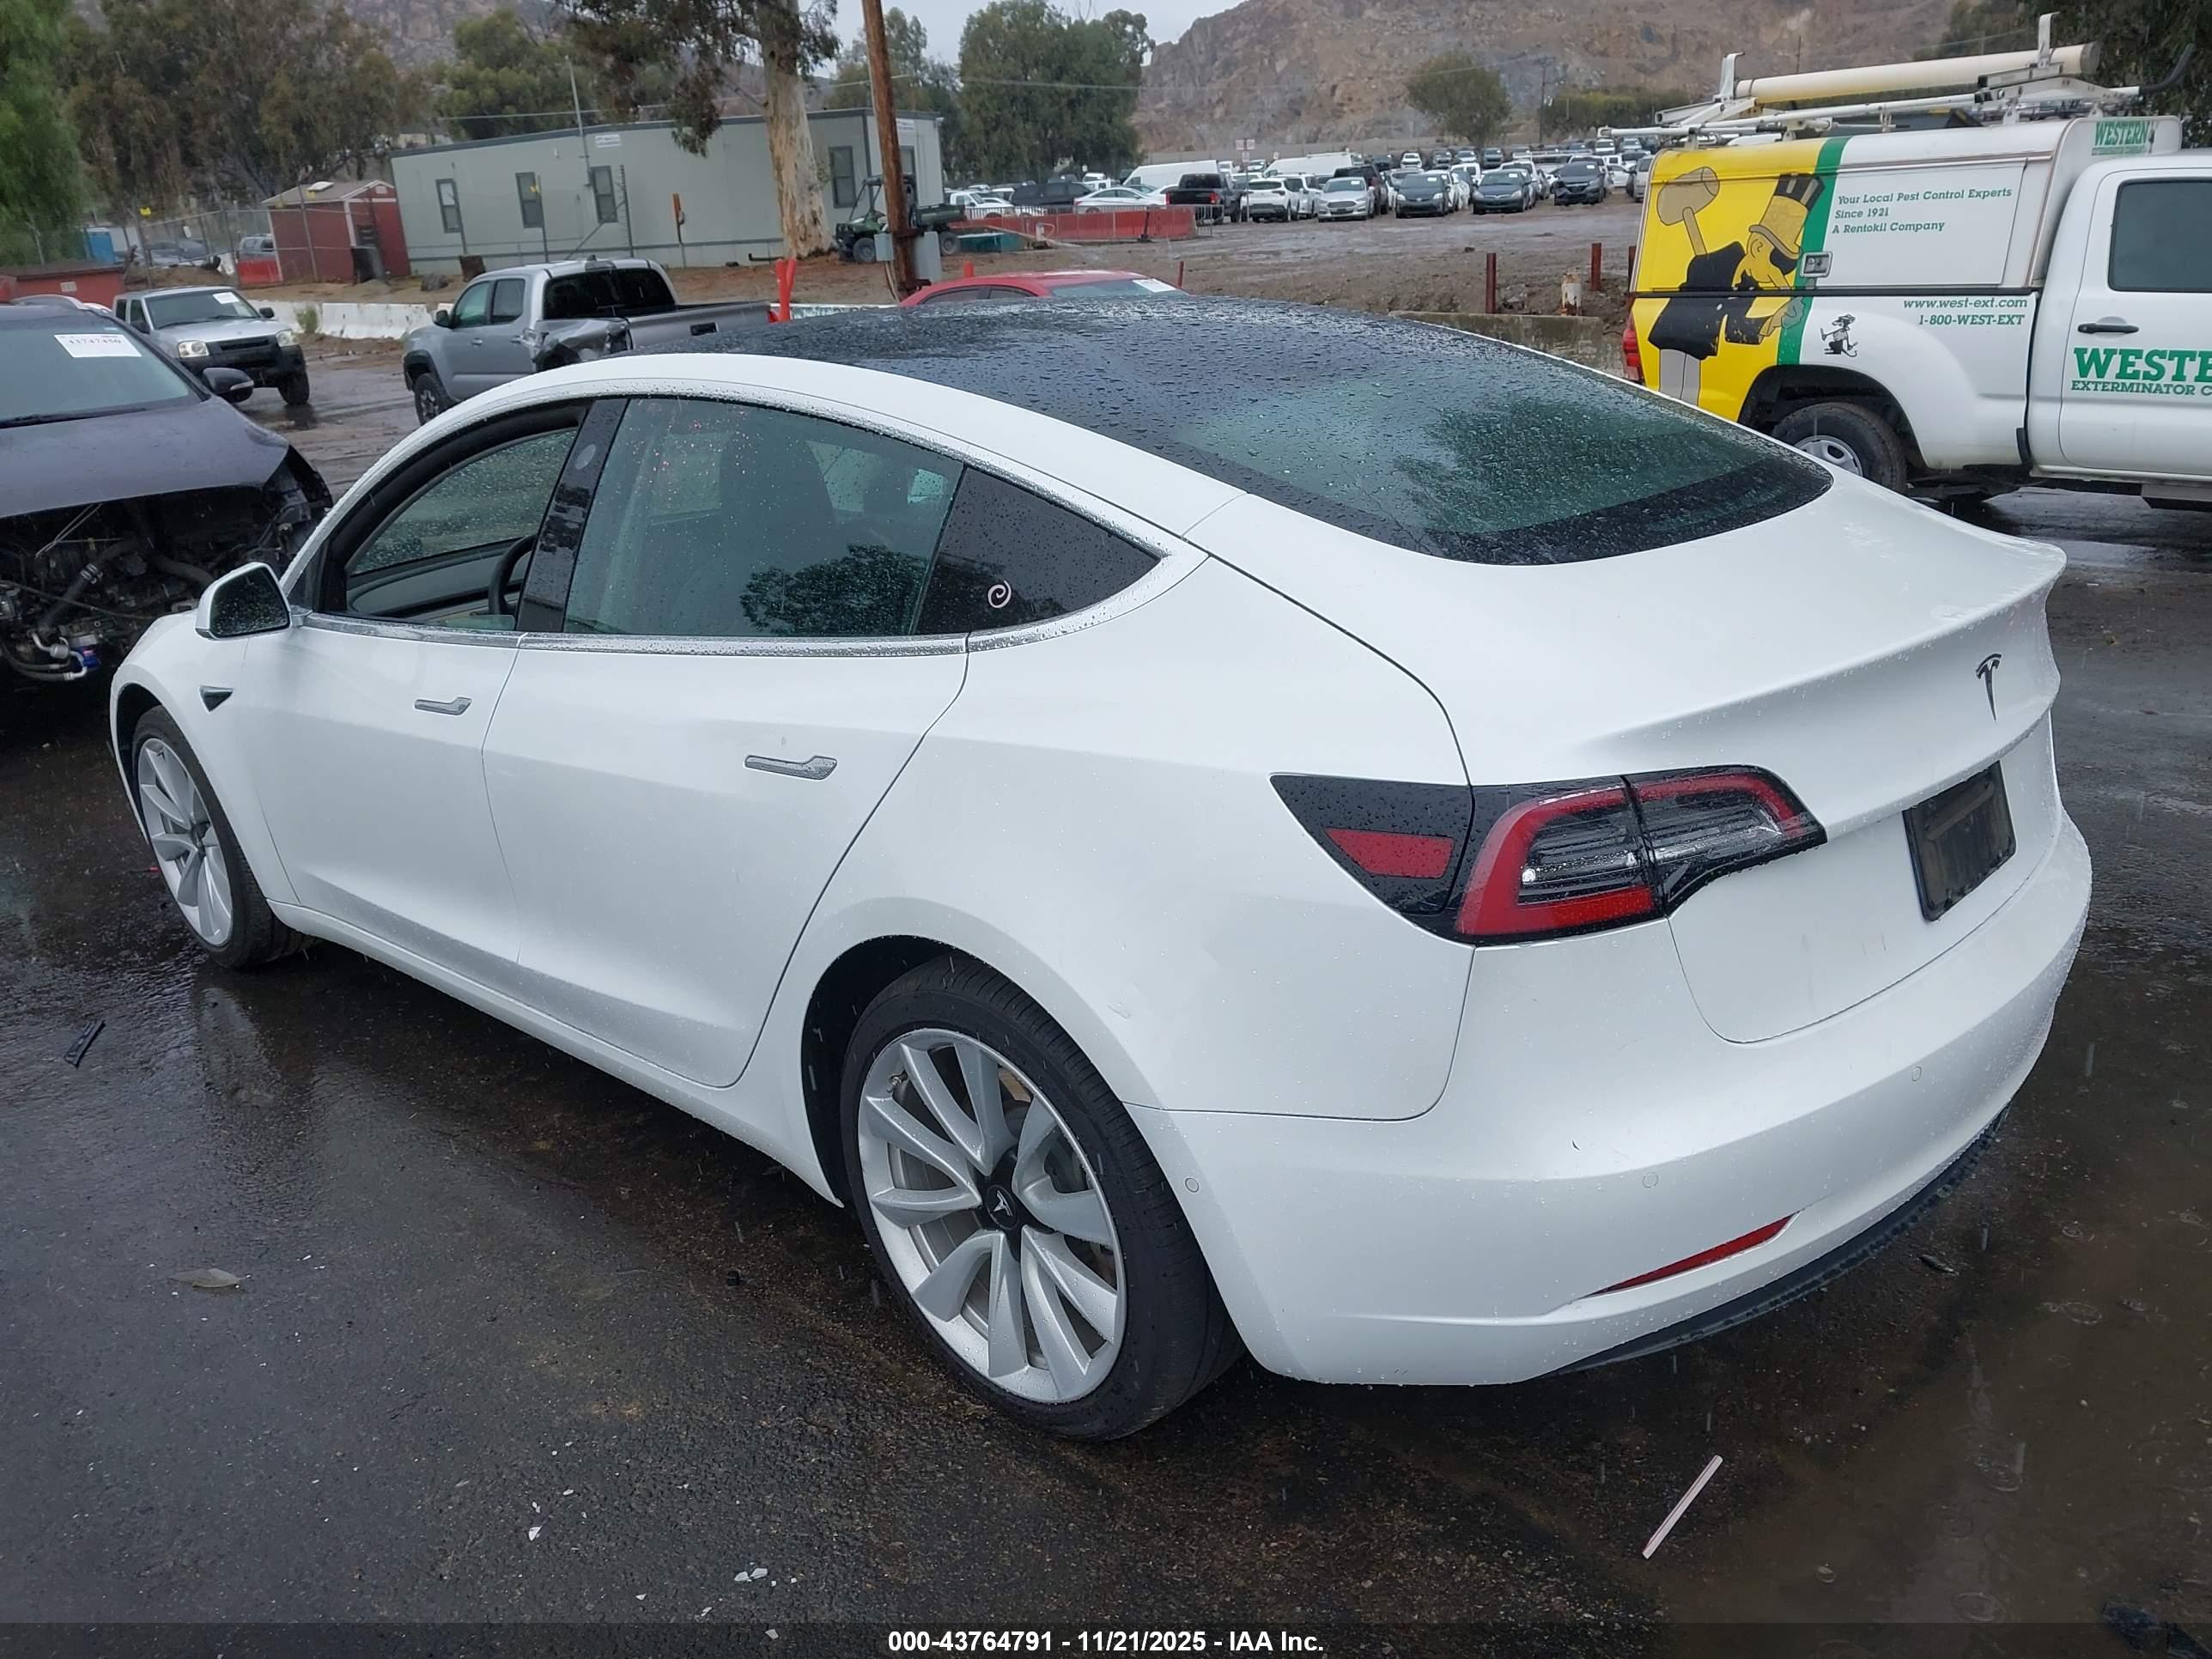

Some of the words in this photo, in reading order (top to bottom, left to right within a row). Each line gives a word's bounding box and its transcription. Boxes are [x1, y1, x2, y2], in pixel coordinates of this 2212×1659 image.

[2094, 120, 2150, 146] WESTERN
[1838, 195, 1860, 205] Your
[1863, 193, 1893, 204] Local
[1896, 191, 1919, 202] Pest
[1923, 189, 1965, 200] Control
[1967, 187, 2013, 198] Experts
[1834, 209, 1863, 219] Since
[1867, 207, 1889, 217] 1921
[1832, 224, 1839, 234] A
[1843, 222, 1887, 234] Rentokil
[1889, 221, 1946, 233] Company
[1903, 297, 2027, 308] www.west-ext.com
[1918, 314, 2026, 325] 1-800-WEST-EXT
[2070, 380, 2196, 396] EXTERMINATOR
